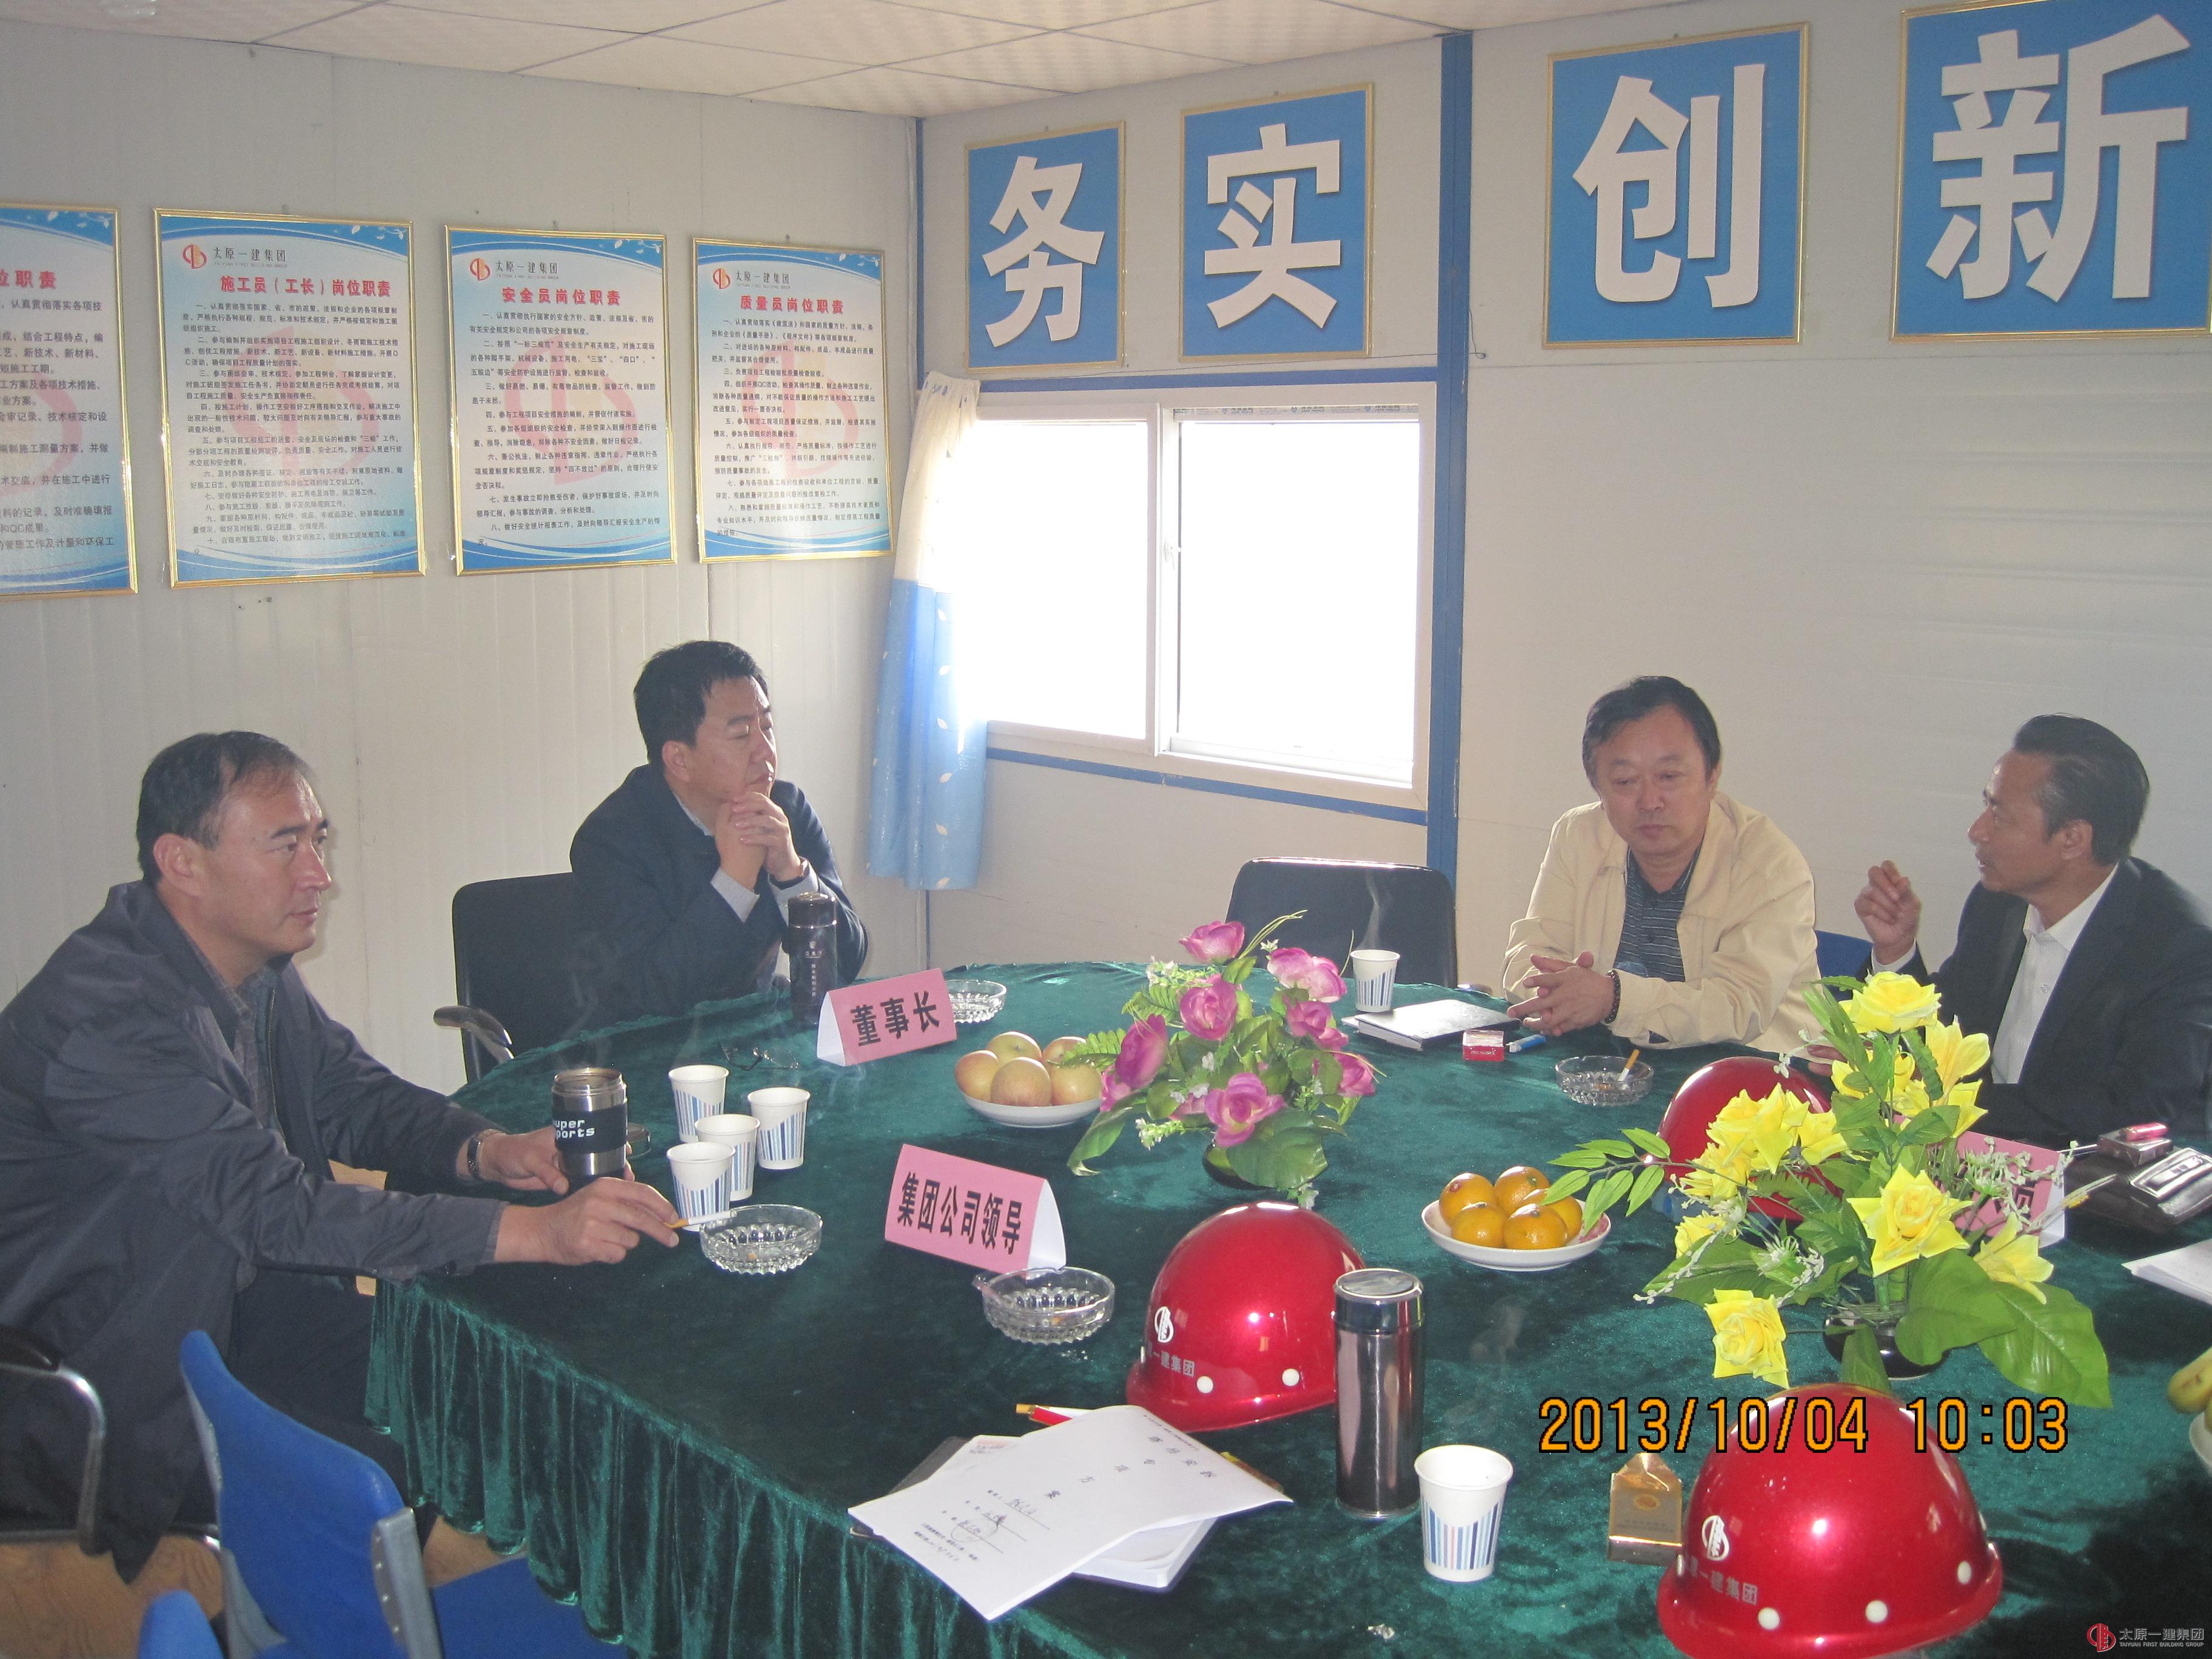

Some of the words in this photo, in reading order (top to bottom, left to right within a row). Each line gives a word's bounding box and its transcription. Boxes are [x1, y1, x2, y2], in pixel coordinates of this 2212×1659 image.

[982, 155, 1105, 347] 务
[1204, 123, 1341, 329] 实
[1572, 63, 1766, 309] 创
[1925, 13, 2192, 303] 新
[213, 247, 286, 261] 太原一建集团
[495, 260, 558, 275] 太原一建集团
[736, 270, 789, 284] 太原一建集团
[221, 275, 391, 297] 施工员（工长）岗位职责
[502, 287, 620, 306] 安全员岗位职责
[740, 295, 844, 315] 质量员岗位职责
[0, 331, 103, 344] 成，结合工程特点，编
[0, 395, 37, 406] 业方案。
[850, 990, 940, 1047] 董事长
[553, 1119, 585, 1130] uper
[897, 1171, 1023, 1255] 集团公司领导
